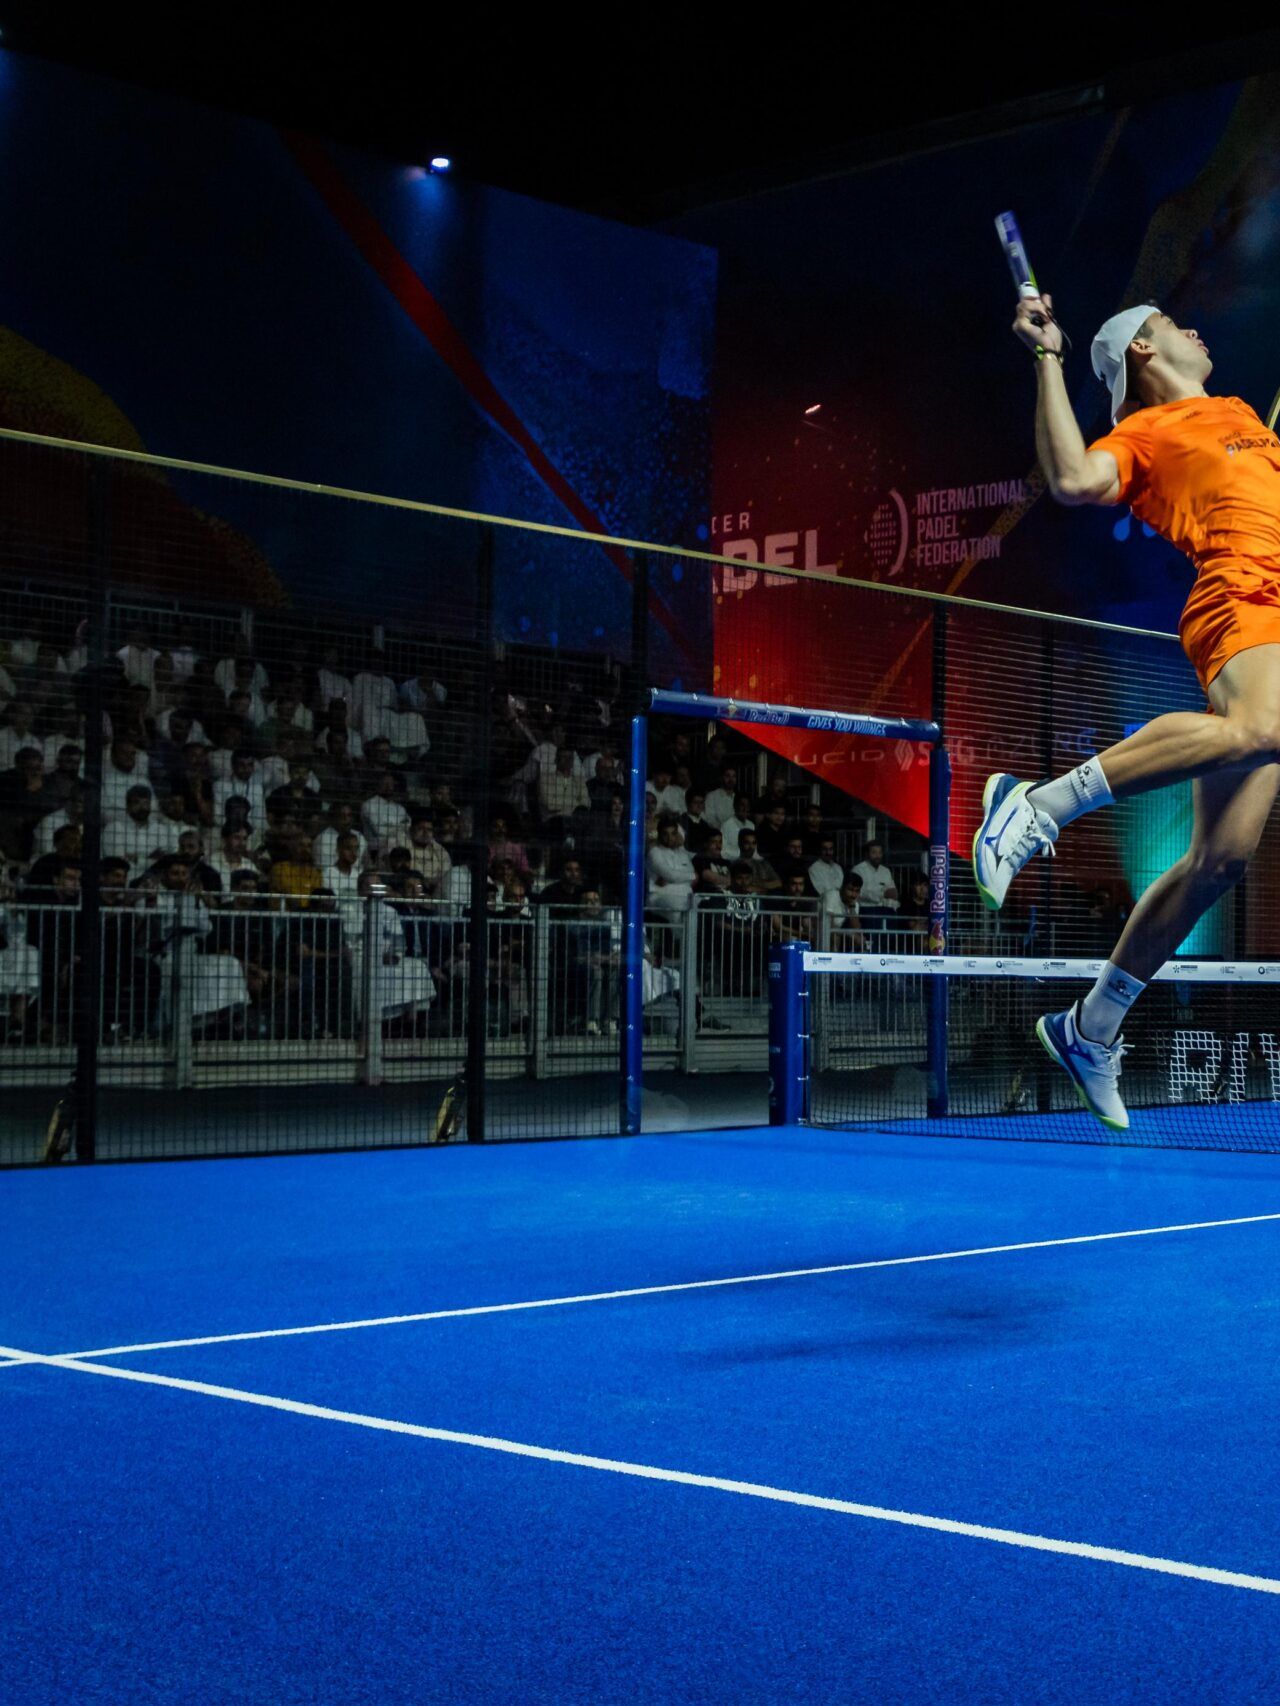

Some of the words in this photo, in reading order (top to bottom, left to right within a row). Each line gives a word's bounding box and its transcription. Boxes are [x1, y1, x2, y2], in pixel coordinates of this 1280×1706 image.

[916, 478, 1026, 516] INTERNATIONAL
[917, 514, 960, 541] PADEL
[712, 528, 839, 595] DEL
[917, 536, 1001, 567] FEDERATION
[807, 715, 832, 730] GIVES
[835, 718, 852, 732] YOU
[793, 749, 885, 766] UCID
[930, 845, 947, 879] Bull
[930, 879, 946, 913] Red
